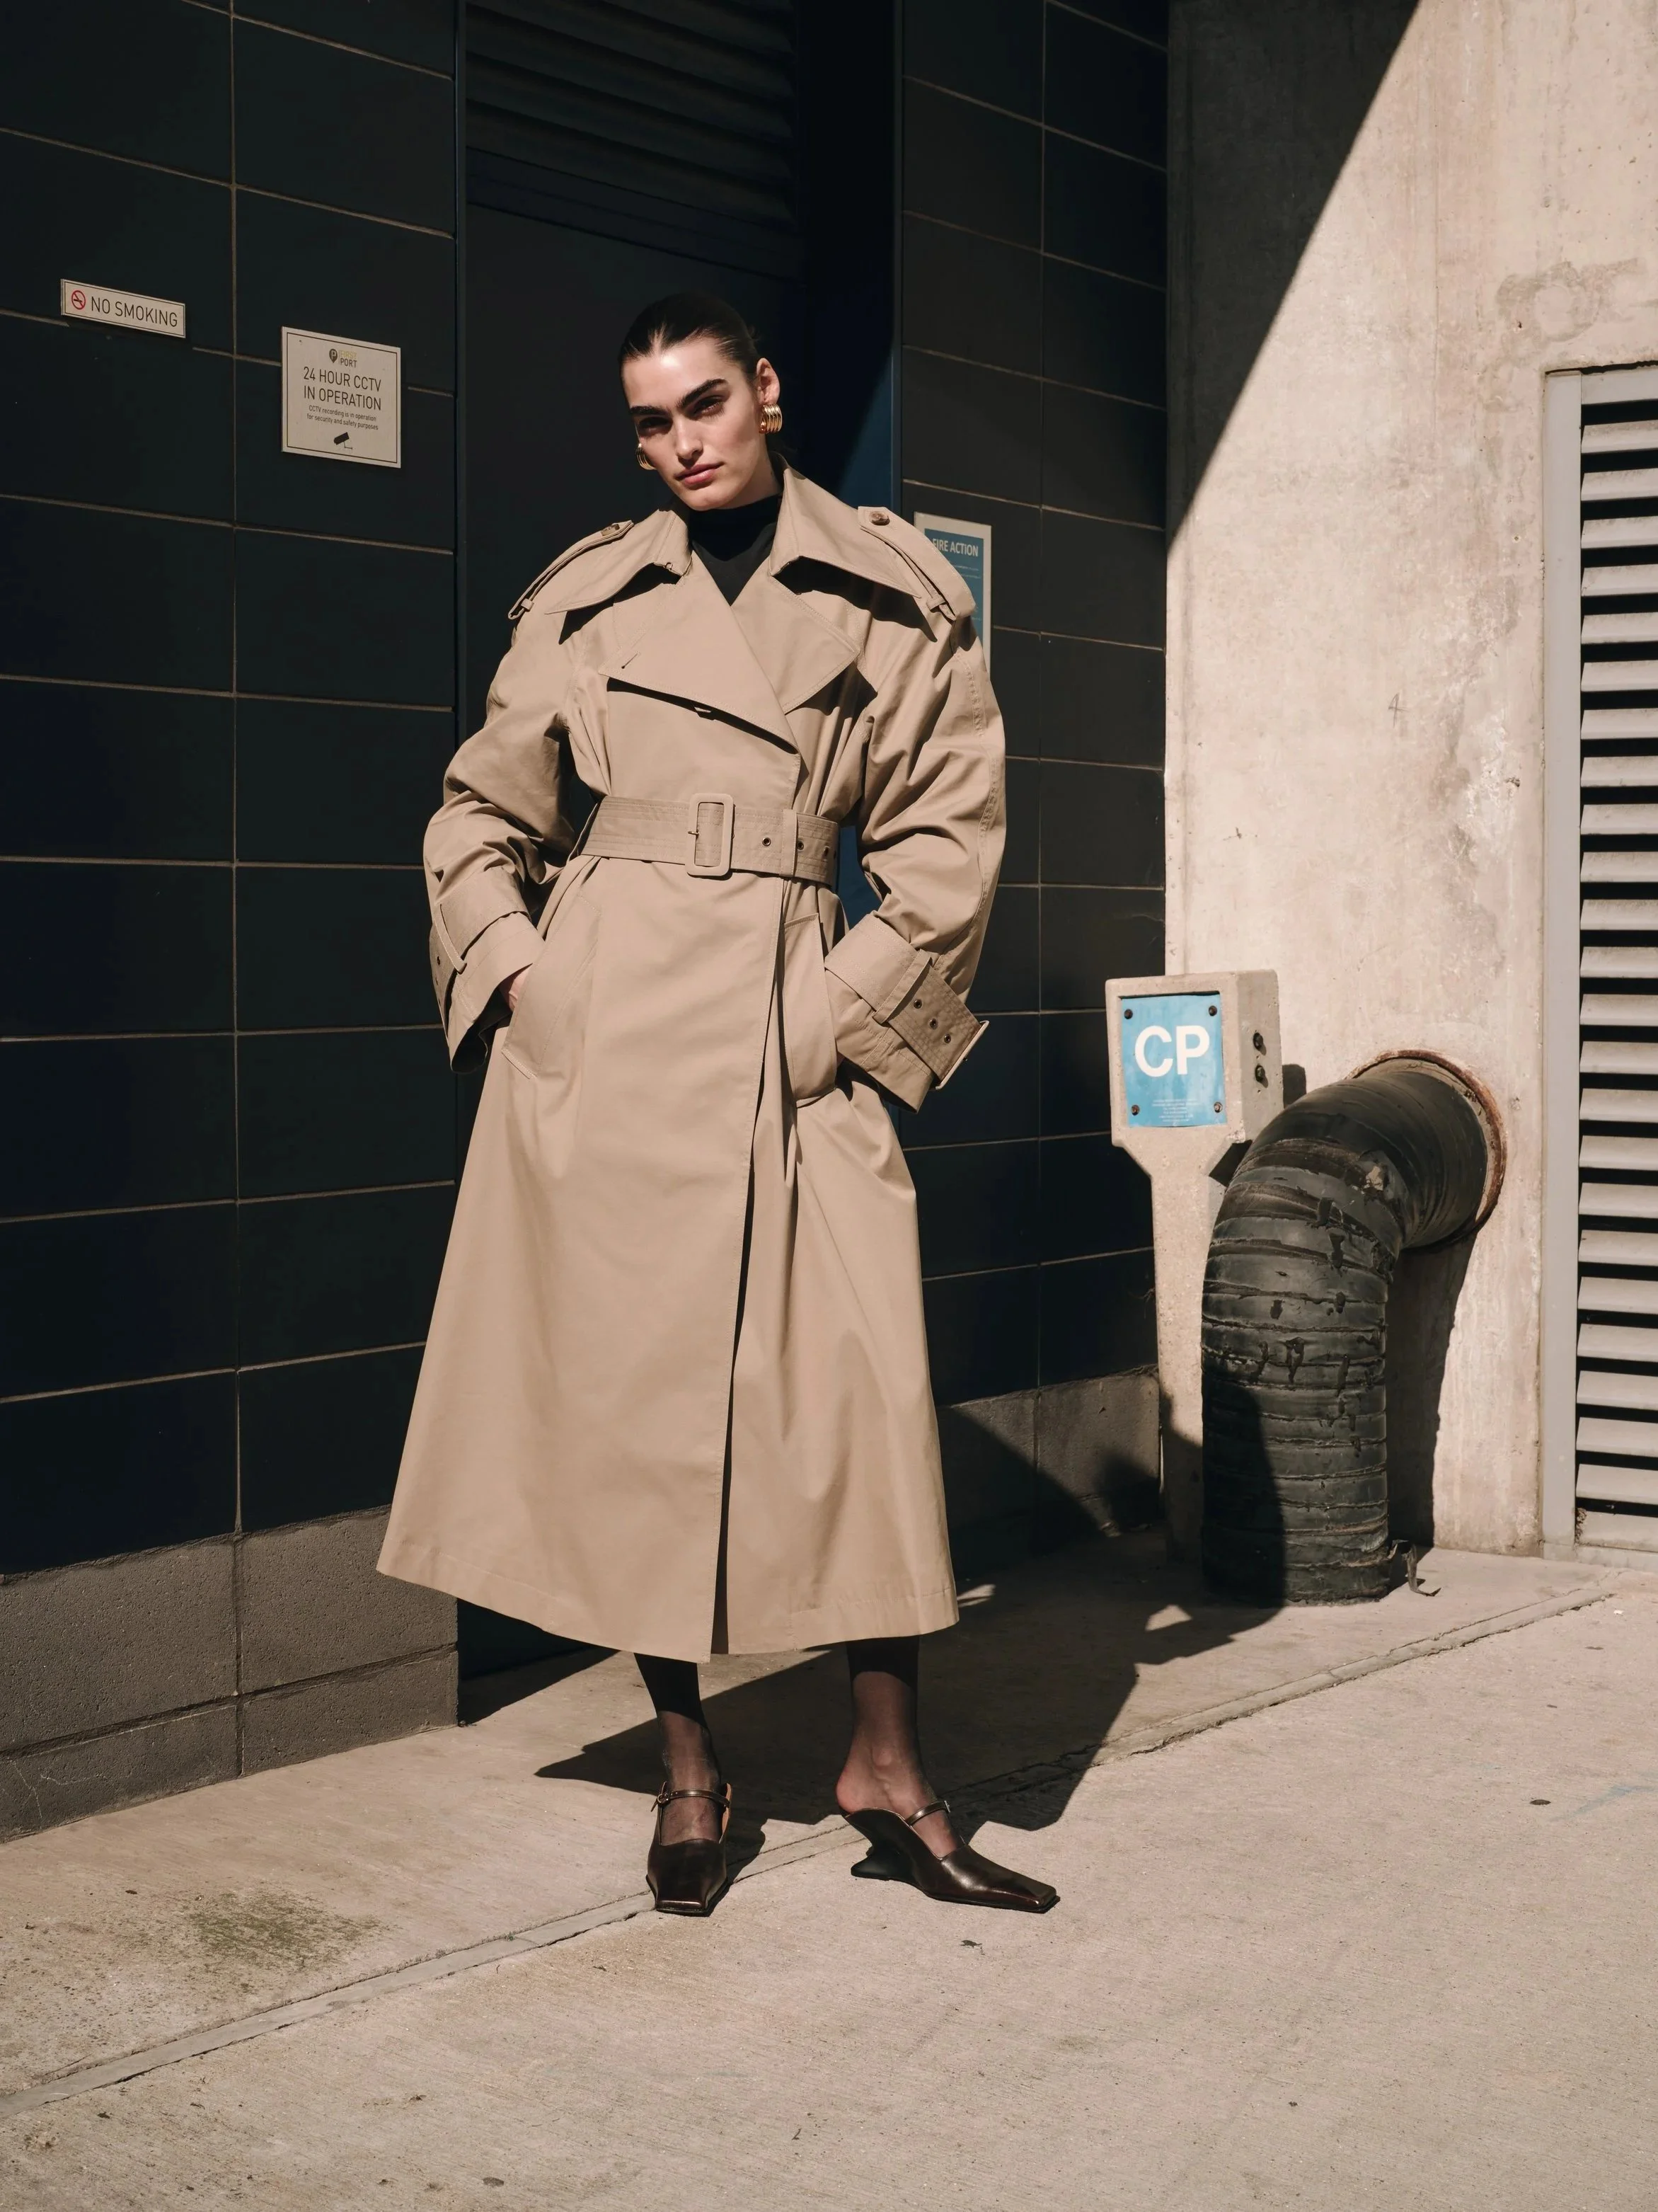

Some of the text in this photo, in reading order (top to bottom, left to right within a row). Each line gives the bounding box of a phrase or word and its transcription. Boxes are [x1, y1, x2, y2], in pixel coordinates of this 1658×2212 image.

[91, 296, 178, 327] NO SMOKING
[340, 357, 357, 368] PORT
[304, 366, 381, 392] 24 HOUR CCTV
[304, 385, 381, 411] IN OPERATION
[314, 416, 333, 425] security
[343, 419, 357, 428] safety
[357, 422, 379, 430] purposes
[322, 408, 345, 418] recording
[355, 413, 377, 422] operation
[950, 541, 979, 557] ACTION
[1134, 1025, 1210, 1078] CP
